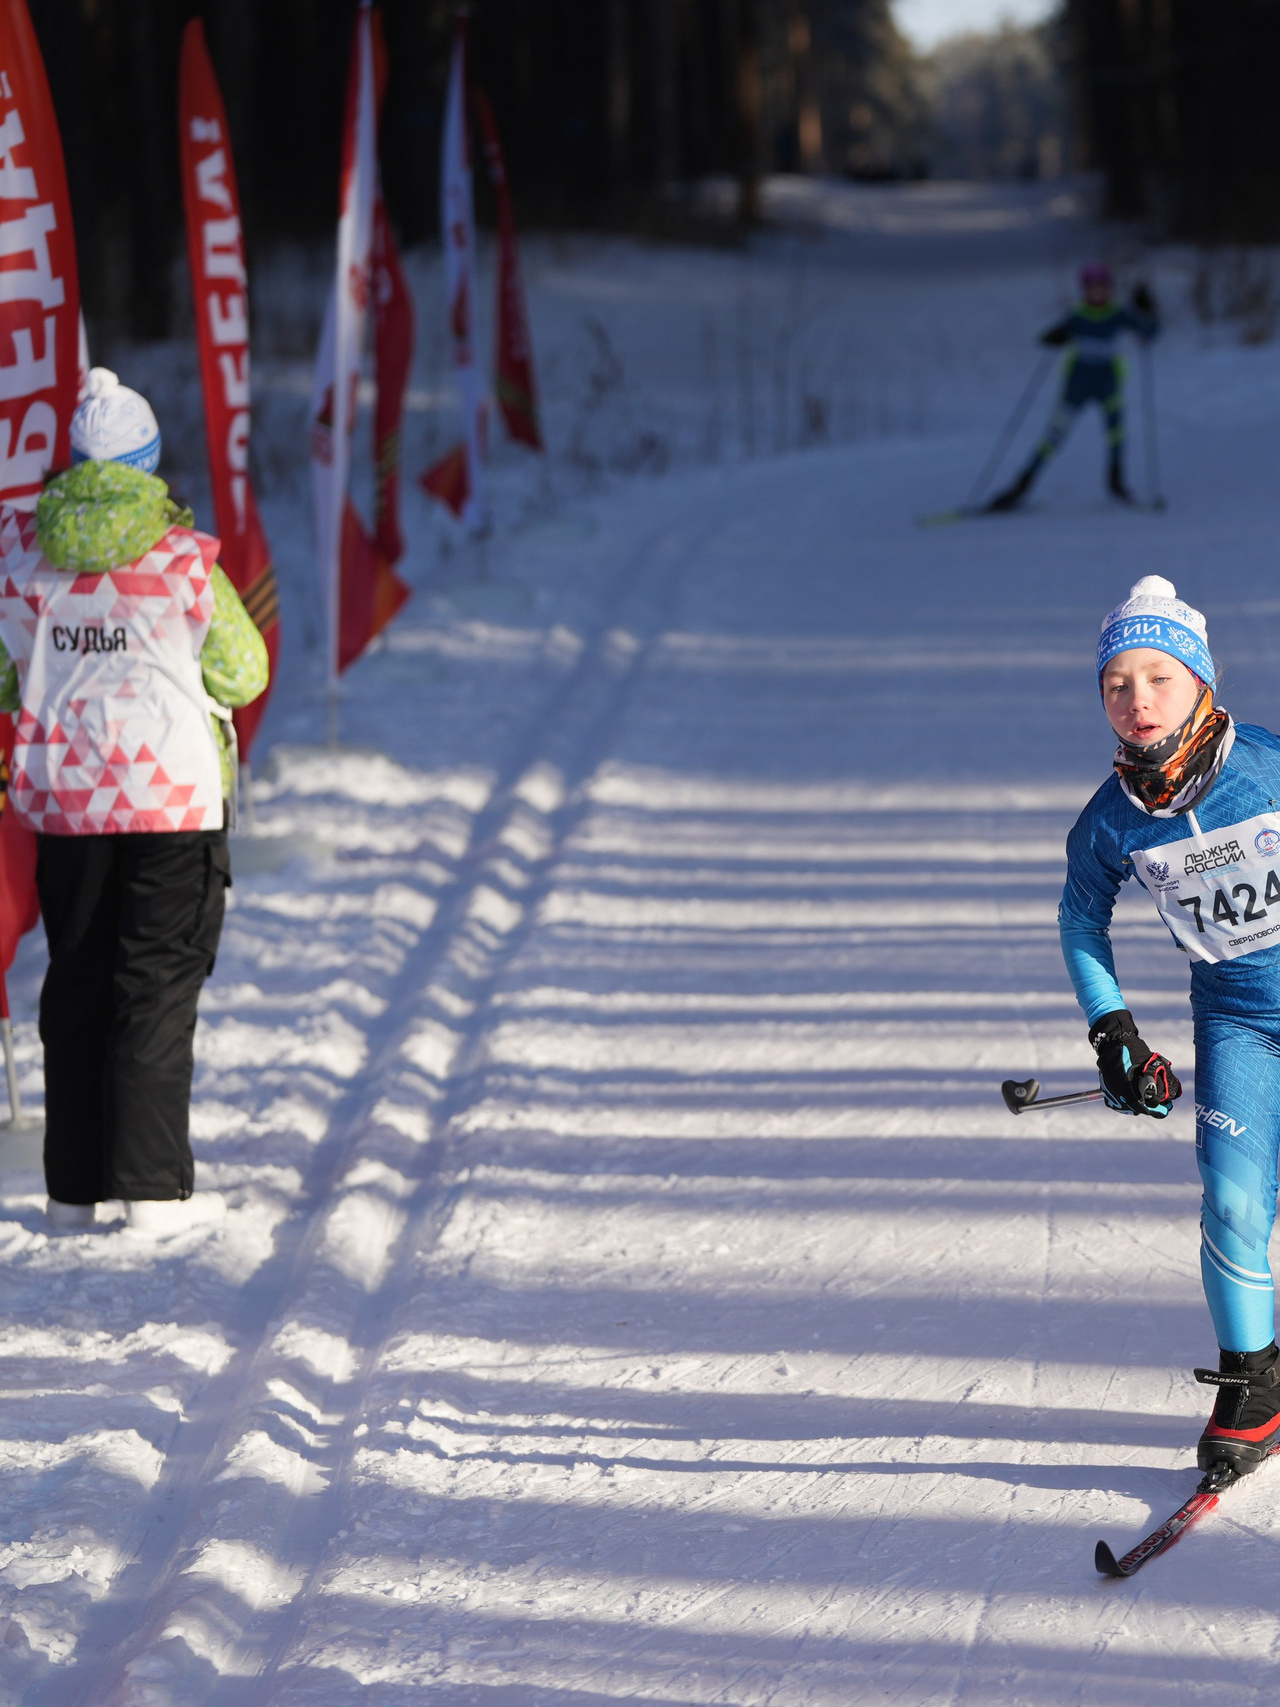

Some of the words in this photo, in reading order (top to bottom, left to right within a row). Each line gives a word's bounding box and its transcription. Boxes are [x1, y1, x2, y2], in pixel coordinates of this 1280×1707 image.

[52, 625, 128, 656] СУДЬЯ
[1098, 623, 1161, 654] ССИИ
[1184, 840, 1240, 866] ЛЫЖНЯ
[1184, 850, 1246, 876] РОССИИ
[1201, 863, 1240, 881] 2025
[1203, 1374, 1250, 1384] MADSHUS
